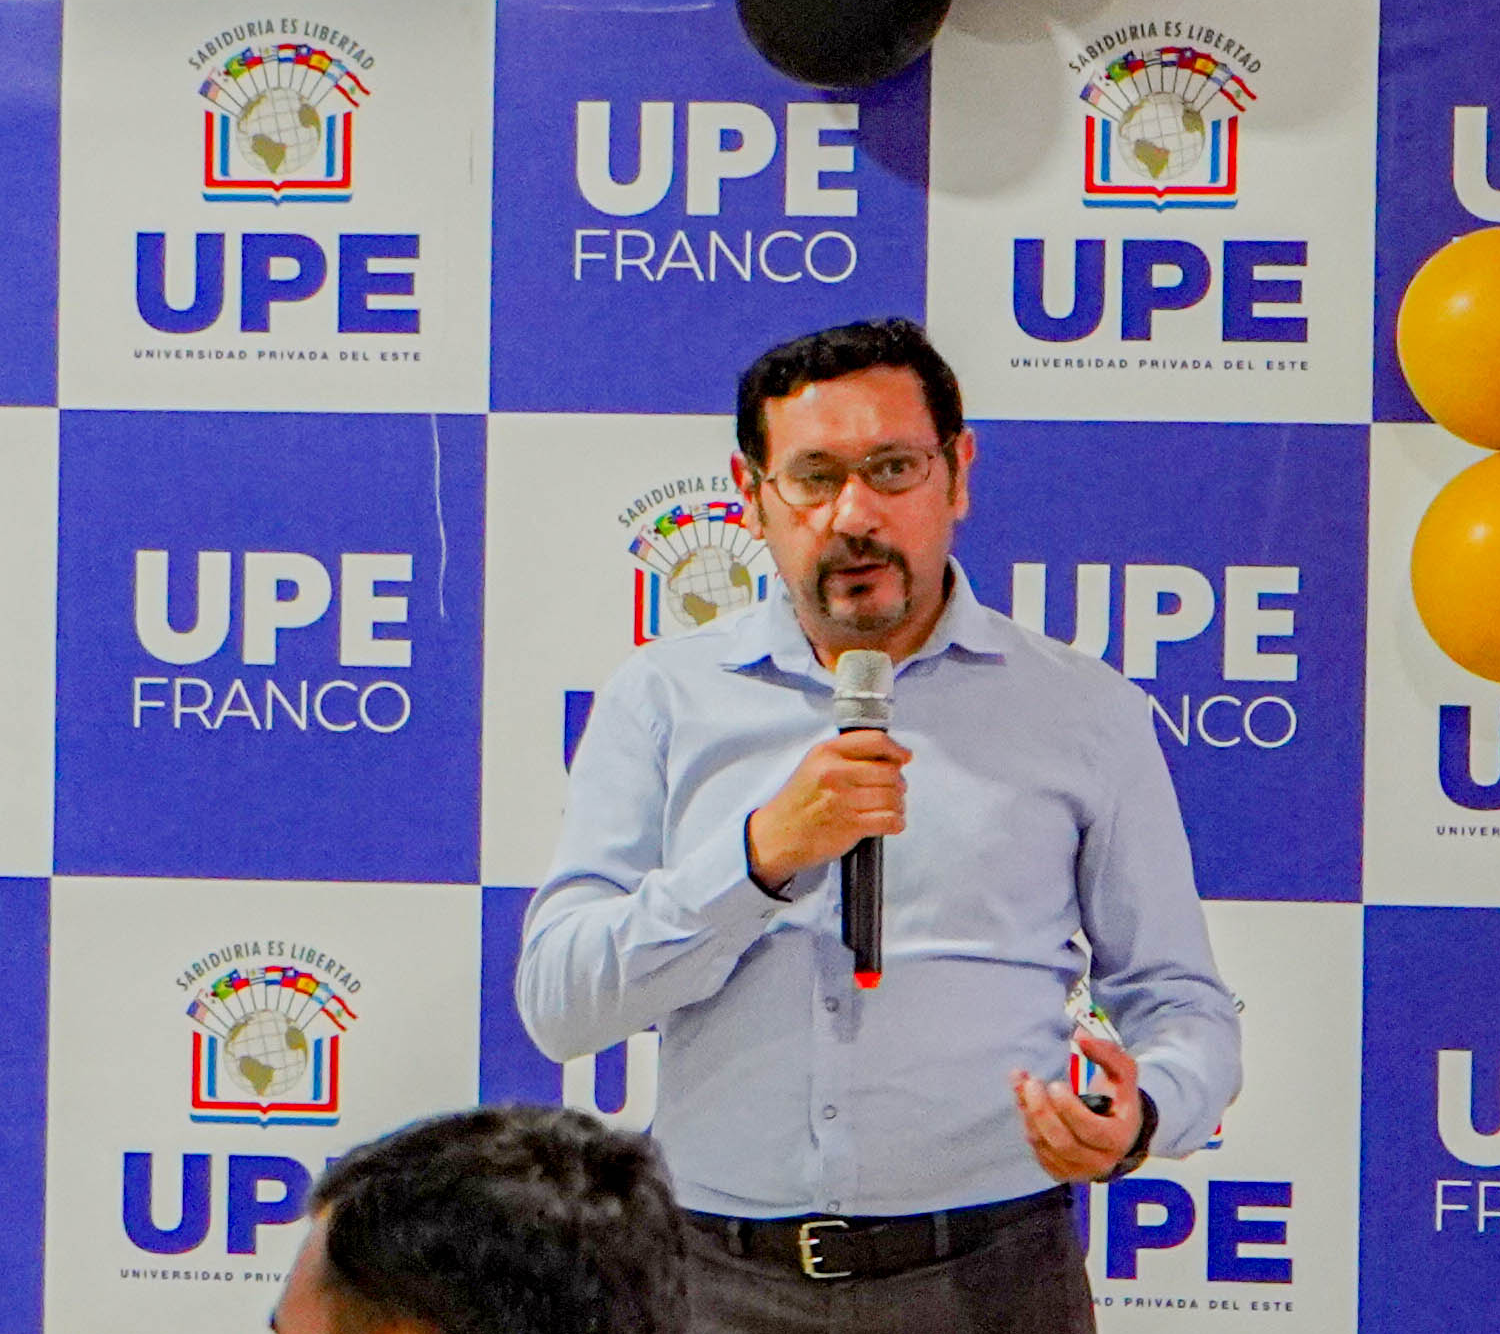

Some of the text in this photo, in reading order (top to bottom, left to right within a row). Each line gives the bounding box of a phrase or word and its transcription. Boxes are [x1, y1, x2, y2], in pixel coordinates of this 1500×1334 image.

[188, 18, 375, 70] SABIDURIA ES LIBERTAD
[1068, 20, 1262, 74] SABIDURIA ES LIBERTAD
[576, 101, 858, 216] UPE
[136, 232, 420, 334] UPE
[575, 229, 857, 283] FRANCO
[1013, 239, 1308, 343] UPE
[133, 349, 421, 362] UNIVERSIDAD PRIVADA DEL ESTE
[1010, 357, 1309, 372] UNIVERSIDAD PRIVADA DEL ESTE
[134, 550, 412, 667] UPE
[134, 677, 410, 732] FRANCO
[176, 941, 361, 994] SABIDURIA ES LIBERTAD
[1075, 1178, 1292, 1284] PE
